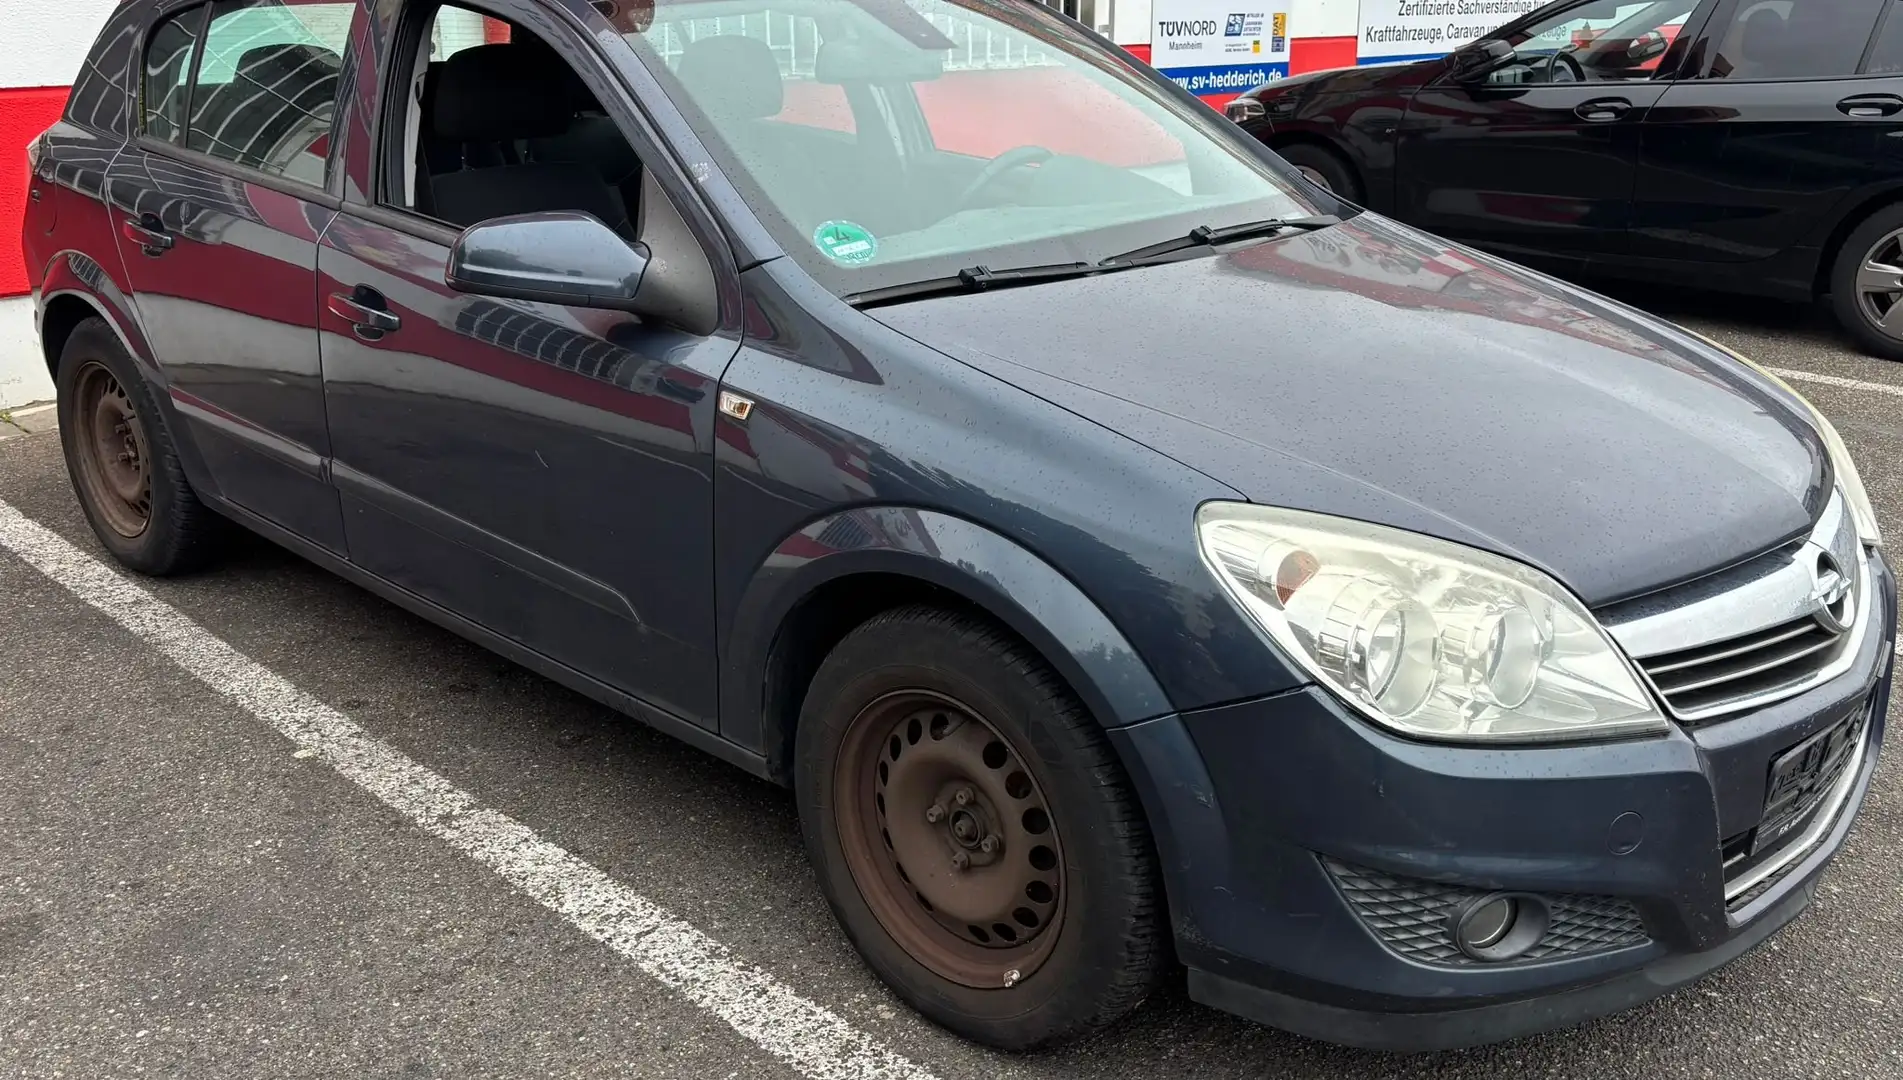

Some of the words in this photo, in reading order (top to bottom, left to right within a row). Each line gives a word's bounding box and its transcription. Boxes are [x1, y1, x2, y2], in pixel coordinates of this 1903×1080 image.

[1398, 0, 1456, 16] Zertifizierte
[1365, 25, 1444, 44] Kraftfahrzeuge,
[1446, 23, 1486, 39] Caravan
[1168, 41, 1203, 51] Mannheim
